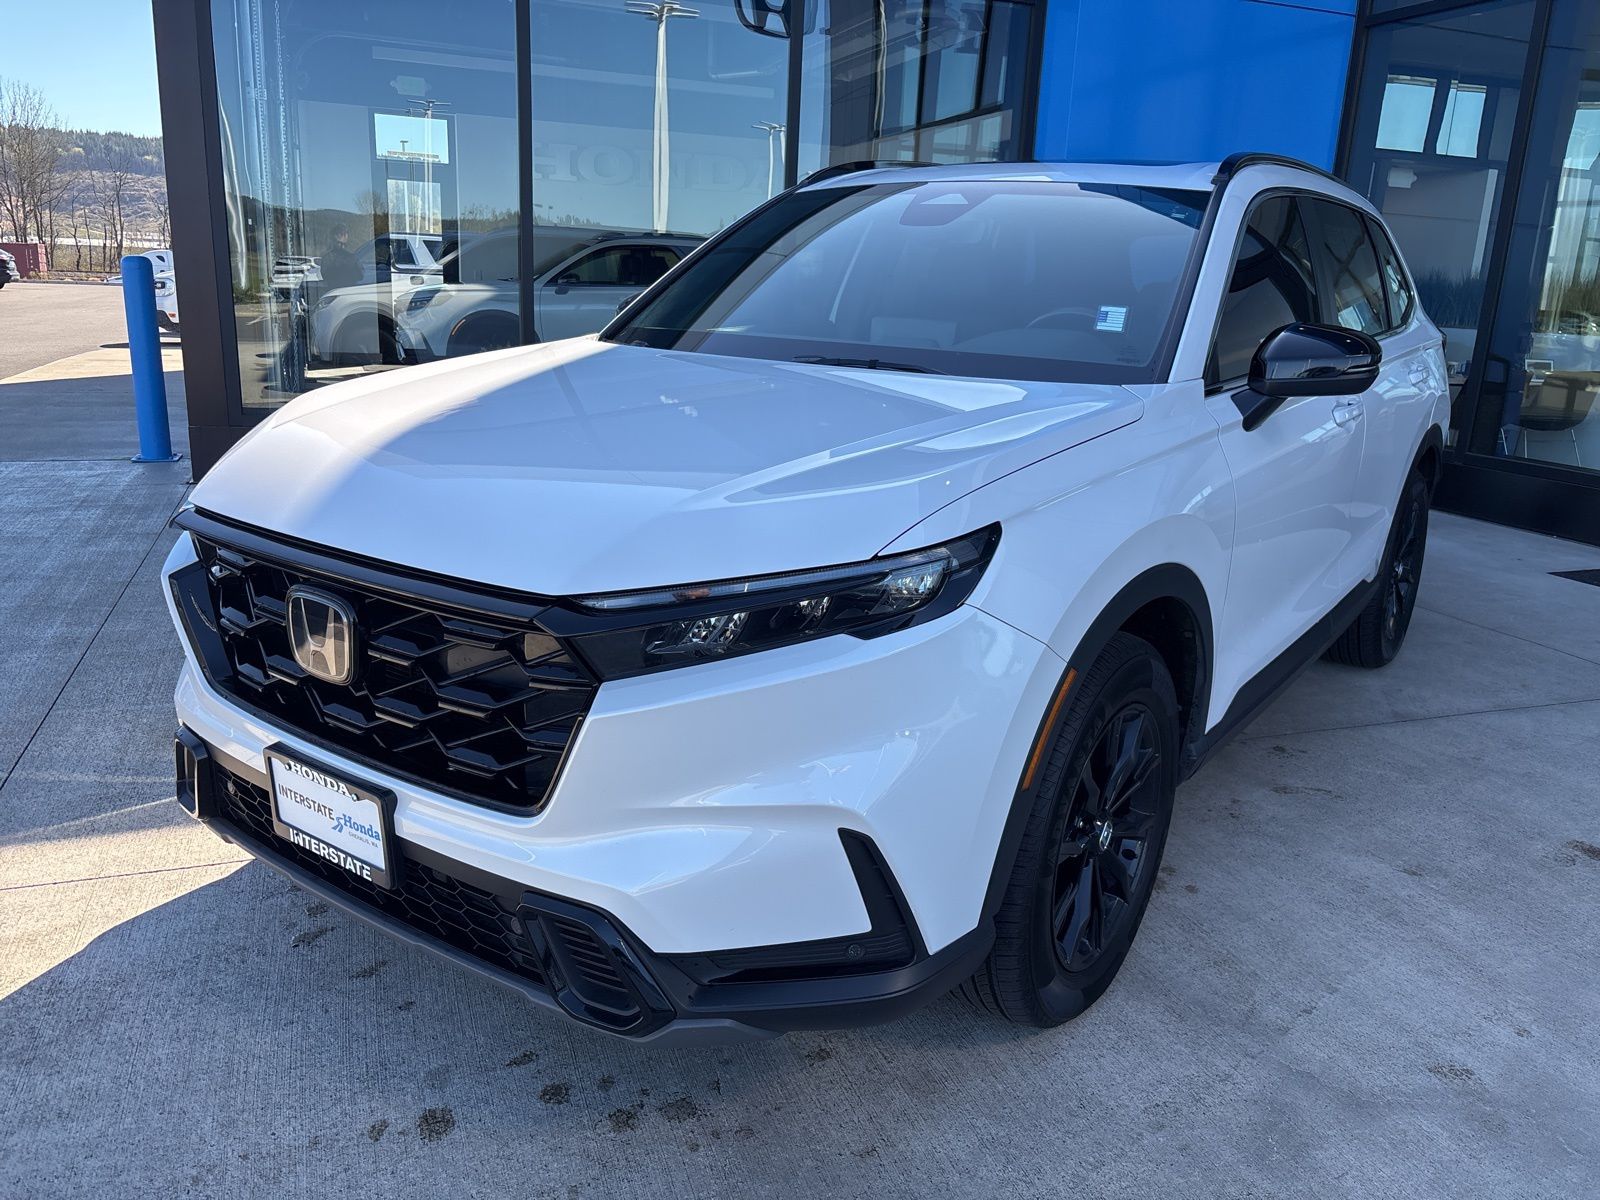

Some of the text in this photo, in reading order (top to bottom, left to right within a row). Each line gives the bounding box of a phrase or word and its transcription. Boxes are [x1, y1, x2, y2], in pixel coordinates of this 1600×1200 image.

[289, 760, 351, 798] HONDA
[278, 783, 335, 820] INTERSTATE
[342, 813, 381, 841] Honda
[290, 828, 373, 881] INTERSTATE
